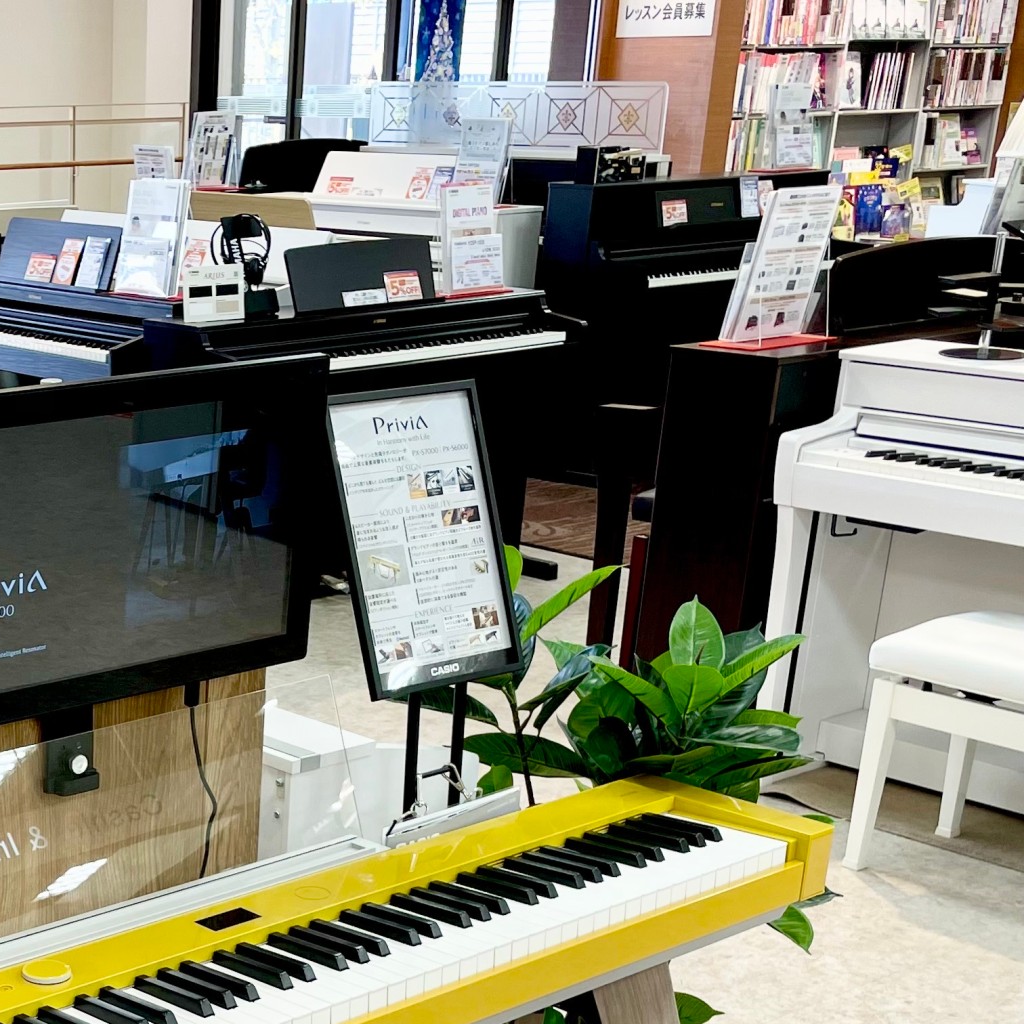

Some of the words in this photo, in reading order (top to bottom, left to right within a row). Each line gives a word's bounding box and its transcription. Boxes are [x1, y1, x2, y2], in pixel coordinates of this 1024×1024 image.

[625, 3, 706, 20] レッスン会員募集
[396, 464, 422, 474] DESIGN
[379, 506, 404, 517] SOUND
[405, 506, 410, 514] &
[411, 501, 451, 513] PLAYABILITY
[414, 604, 453, 618] EXPERIENCE
[430, 663, 460, 677] CASIO
